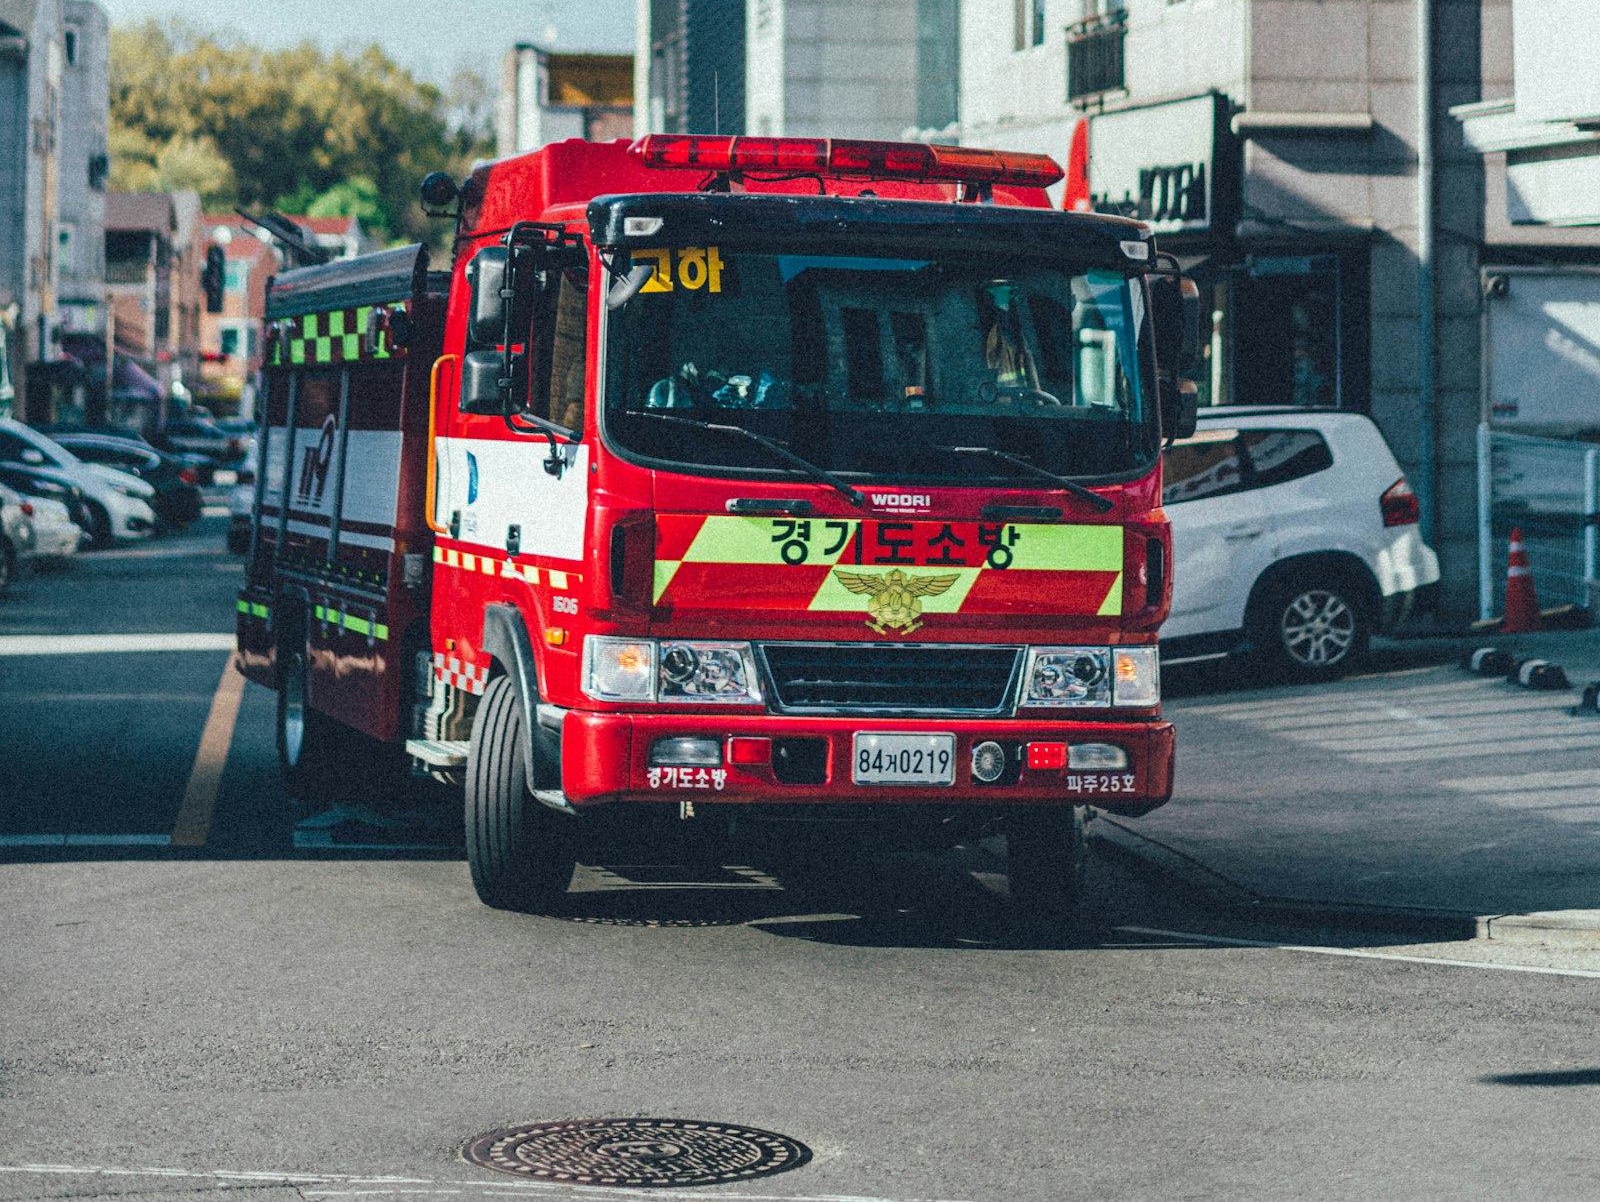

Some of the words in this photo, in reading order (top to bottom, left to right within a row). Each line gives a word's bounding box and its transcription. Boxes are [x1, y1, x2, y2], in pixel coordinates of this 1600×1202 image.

[871, 493, 931, 507] WOORI
[771, 519, 1021, 571] 경기도소방
[859, 748, 950, 774] 84거0219
[646, 766, 728, 791] 경기도소방
[1066, 773, 1136, 794] 파주25호
